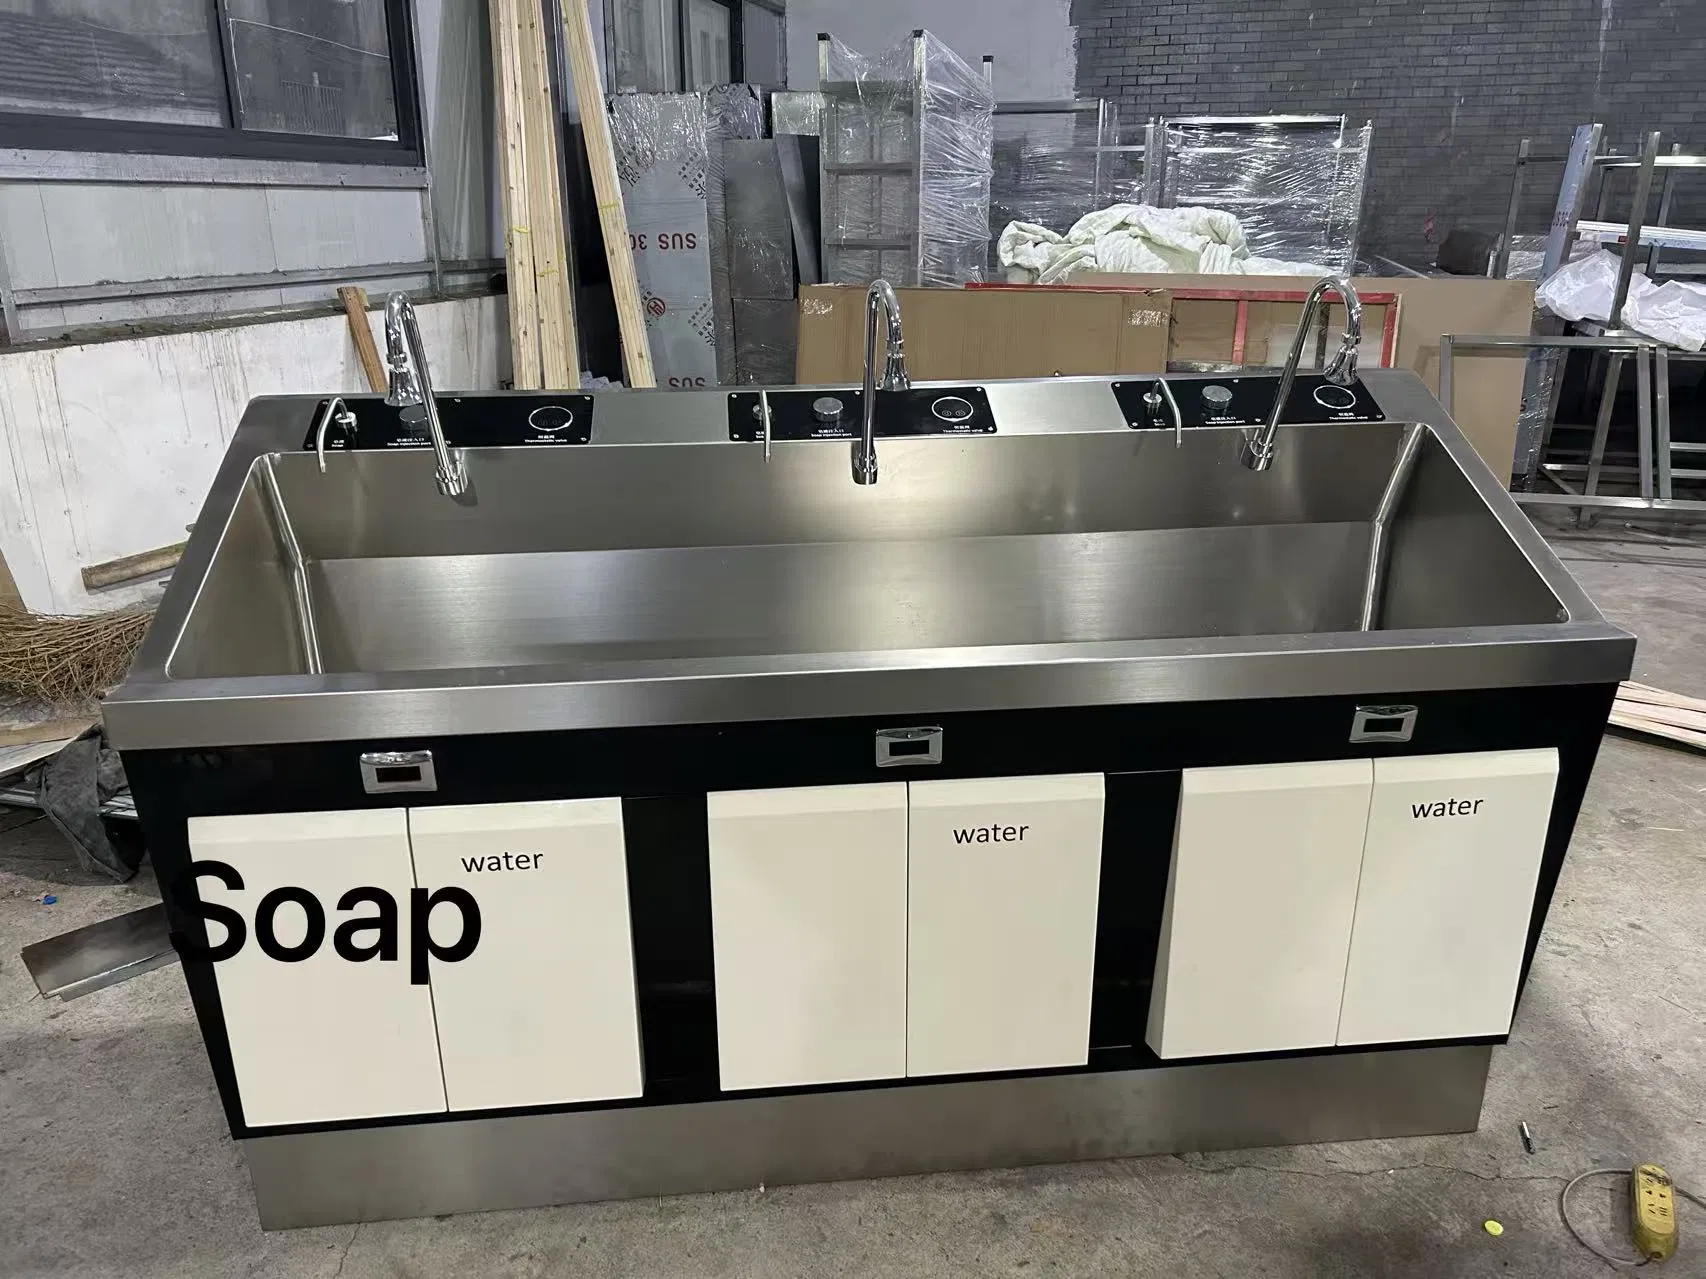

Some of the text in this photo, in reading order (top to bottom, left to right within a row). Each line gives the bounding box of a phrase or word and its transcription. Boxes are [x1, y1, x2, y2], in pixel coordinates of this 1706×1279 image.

[658, 232, 697, 250] SUS
[1411, 798, 1484, 819] water
[953, 823, 1030, 844] water
[461, 851, 544, 873] water
